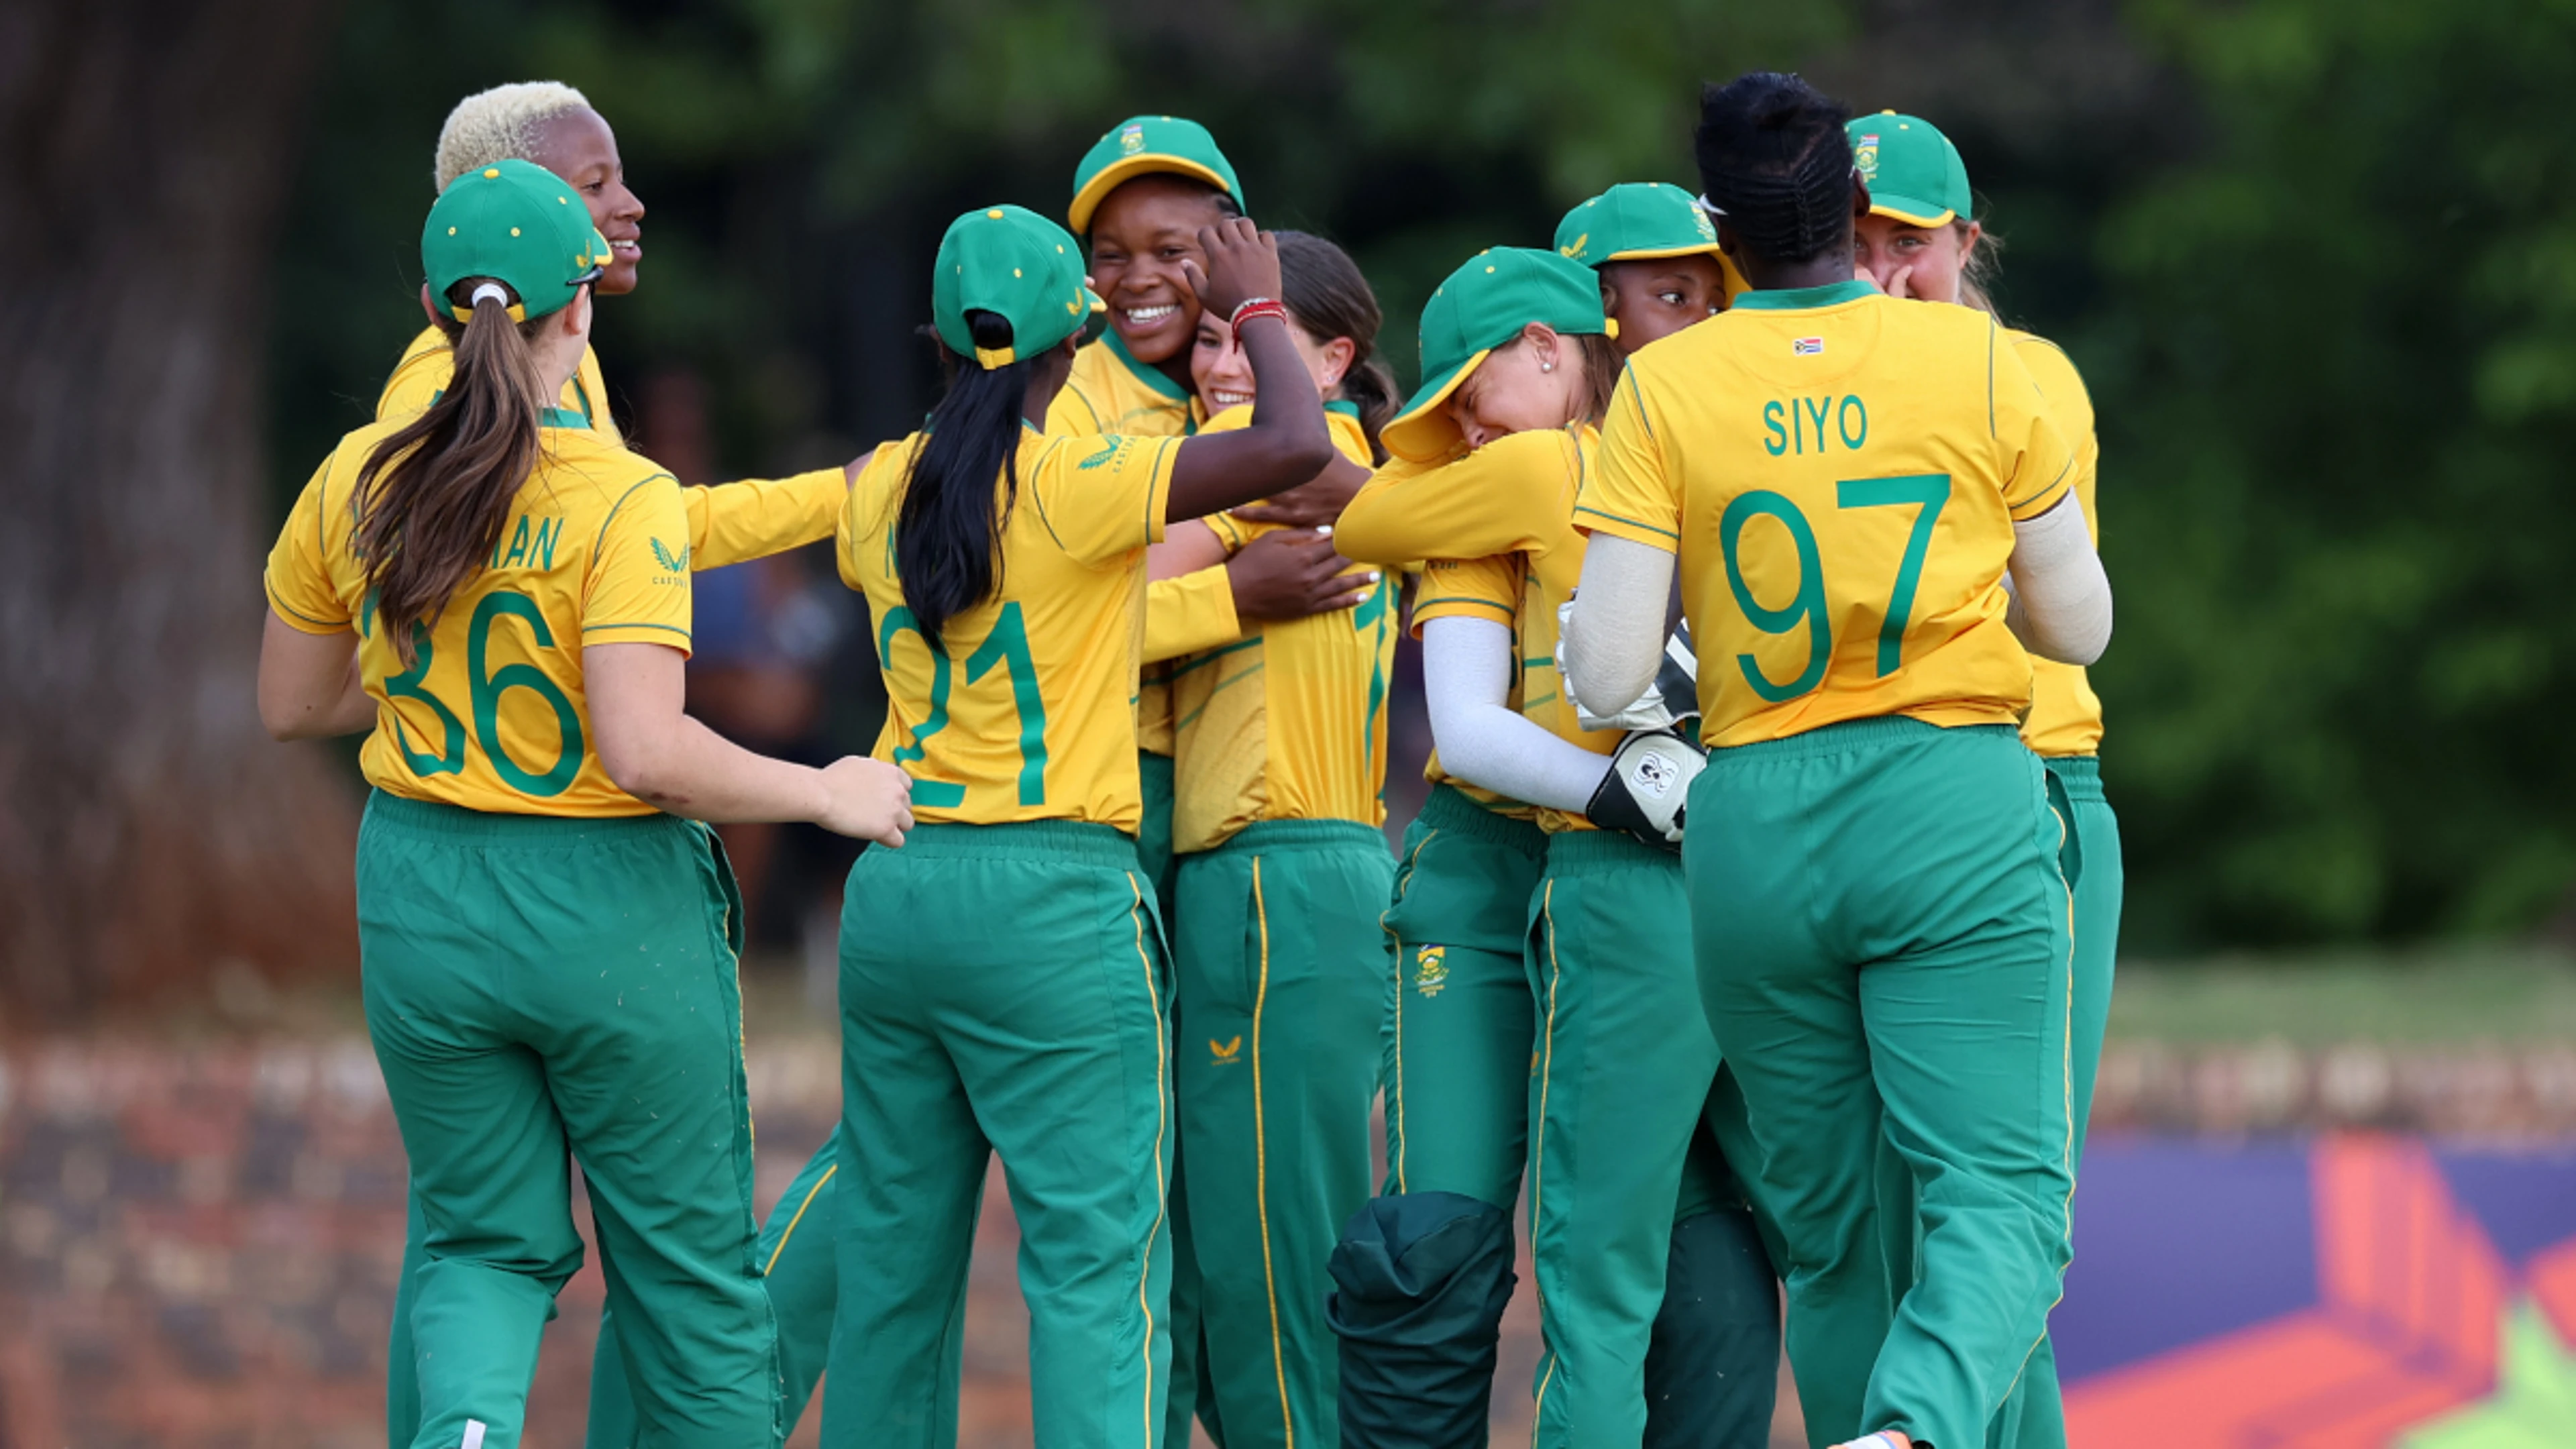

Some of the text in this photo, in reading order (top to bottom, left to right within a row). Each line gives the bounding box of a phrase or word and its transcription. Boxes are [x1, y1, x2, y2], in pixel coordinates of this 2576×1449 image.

[1764, 394, 1867, 457] SIYO
[1720, 474, 1951, 703] 97
[362, 589, 584, 798] 36
[879, 601, 1049, 808] 21
